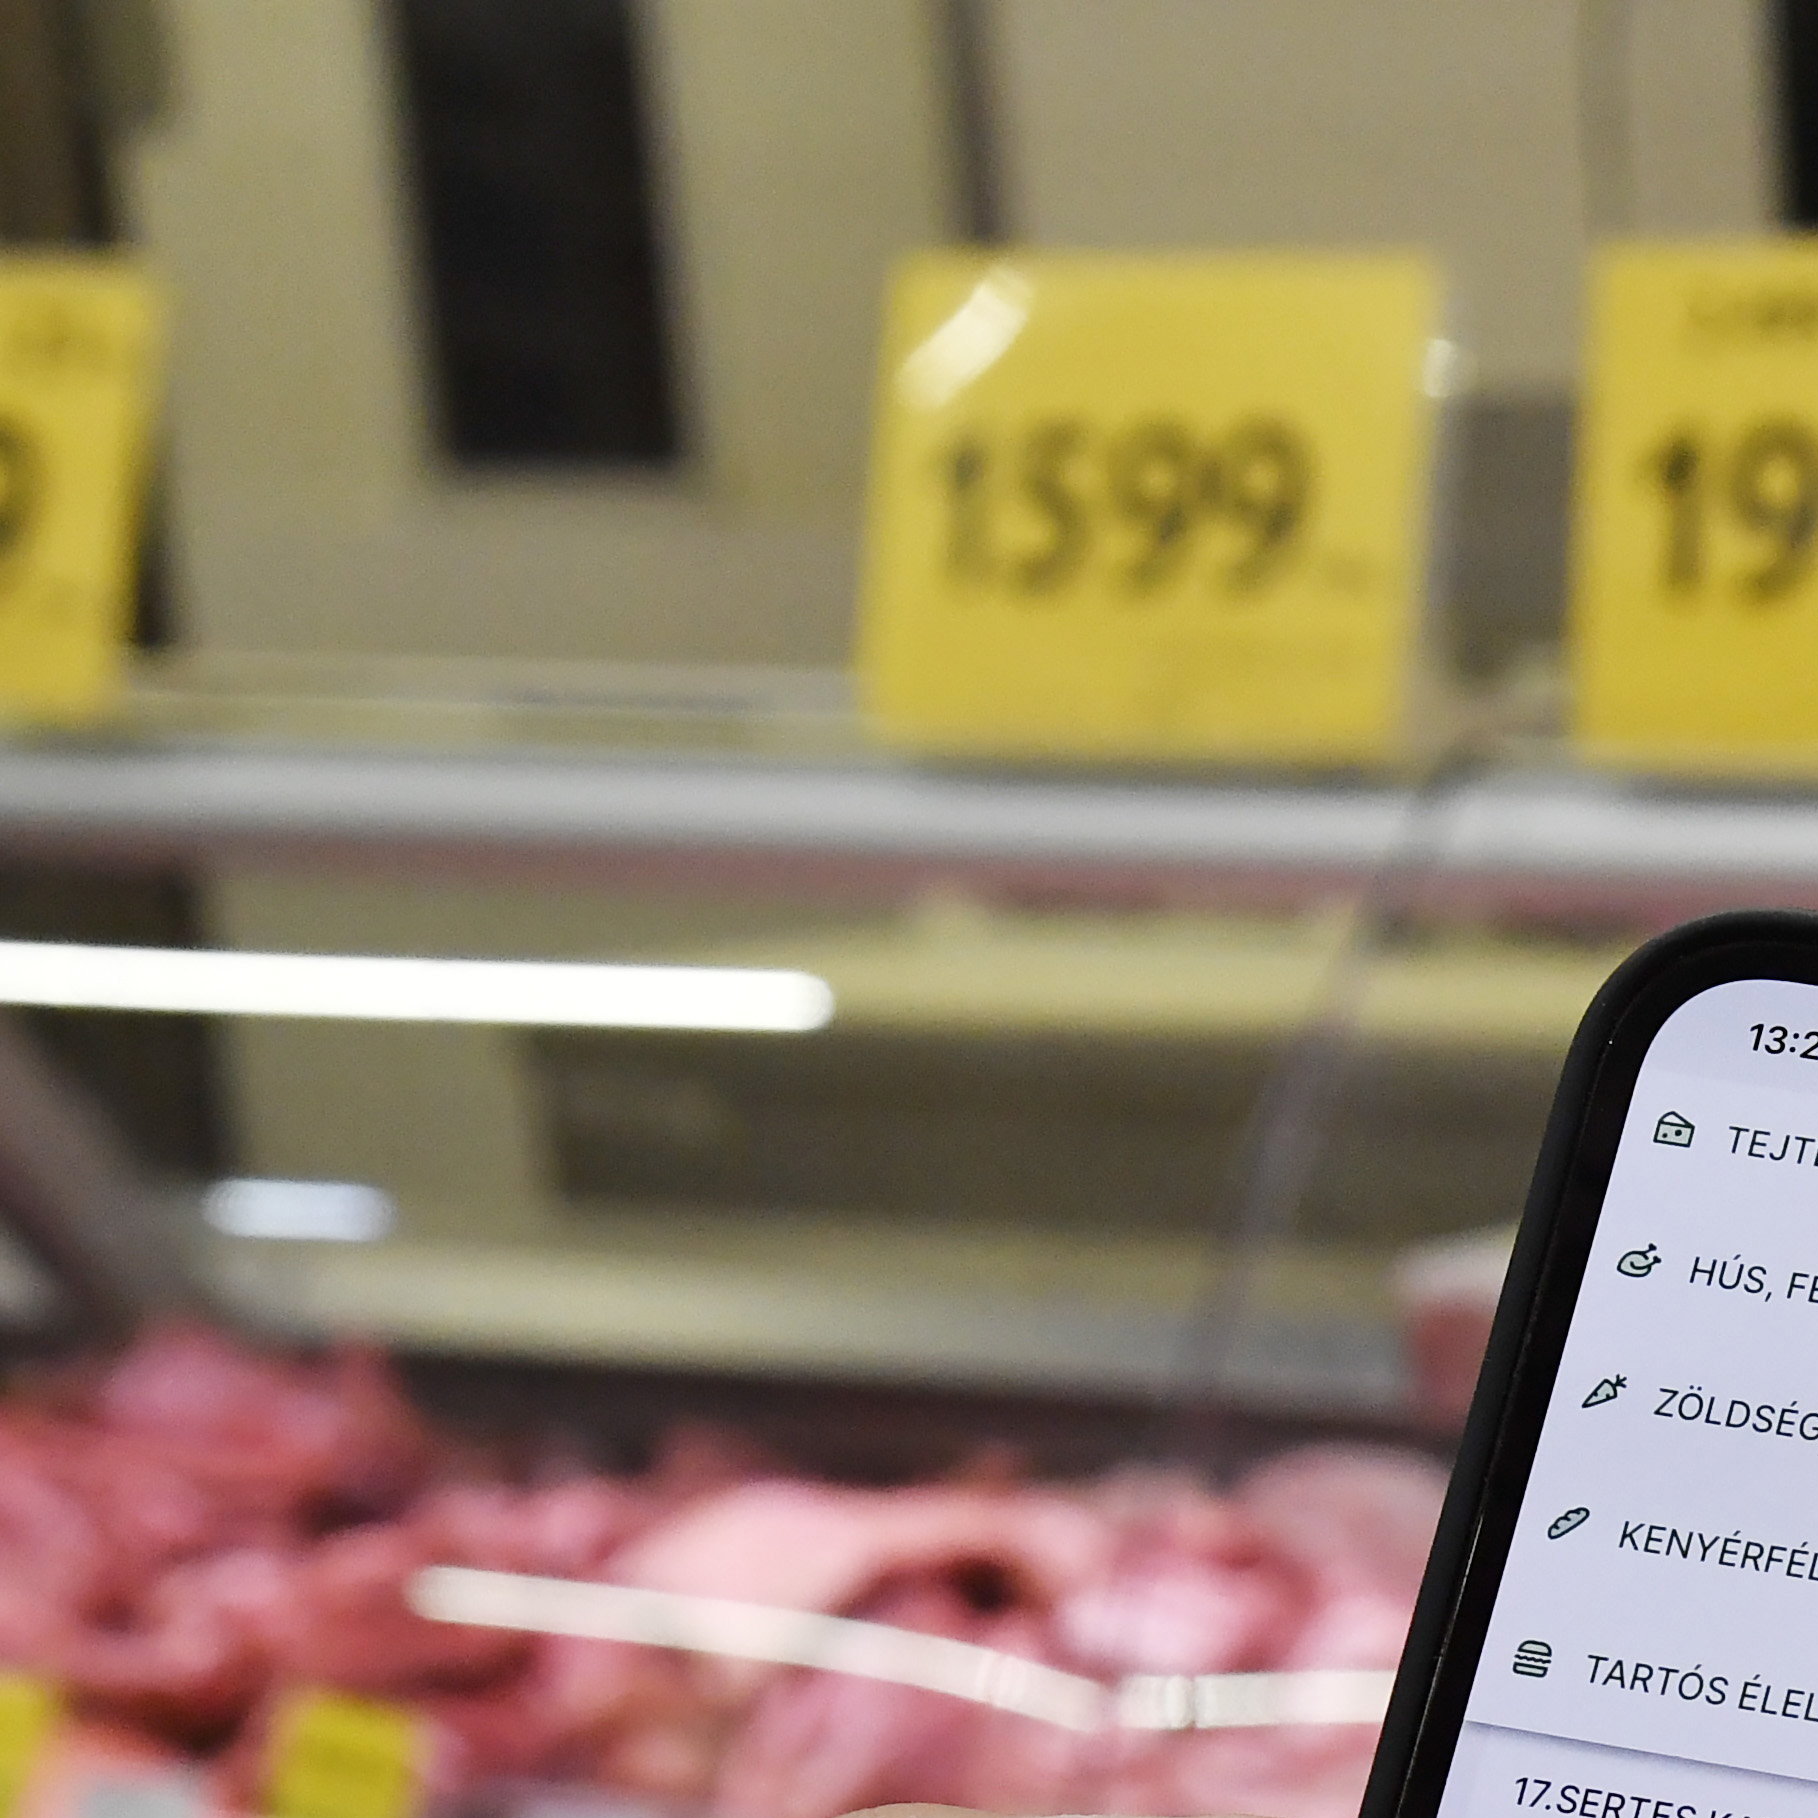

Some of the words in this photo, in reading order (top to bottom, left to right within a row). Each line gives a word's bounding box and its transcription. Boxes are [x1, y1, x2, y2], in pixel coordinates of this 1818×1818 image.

[935, 410, 1320, 602] 1599
[1689, 1254, 1772, 1303] HÚS,
[1587, 1654, 1729, 1706] TARTÓS
